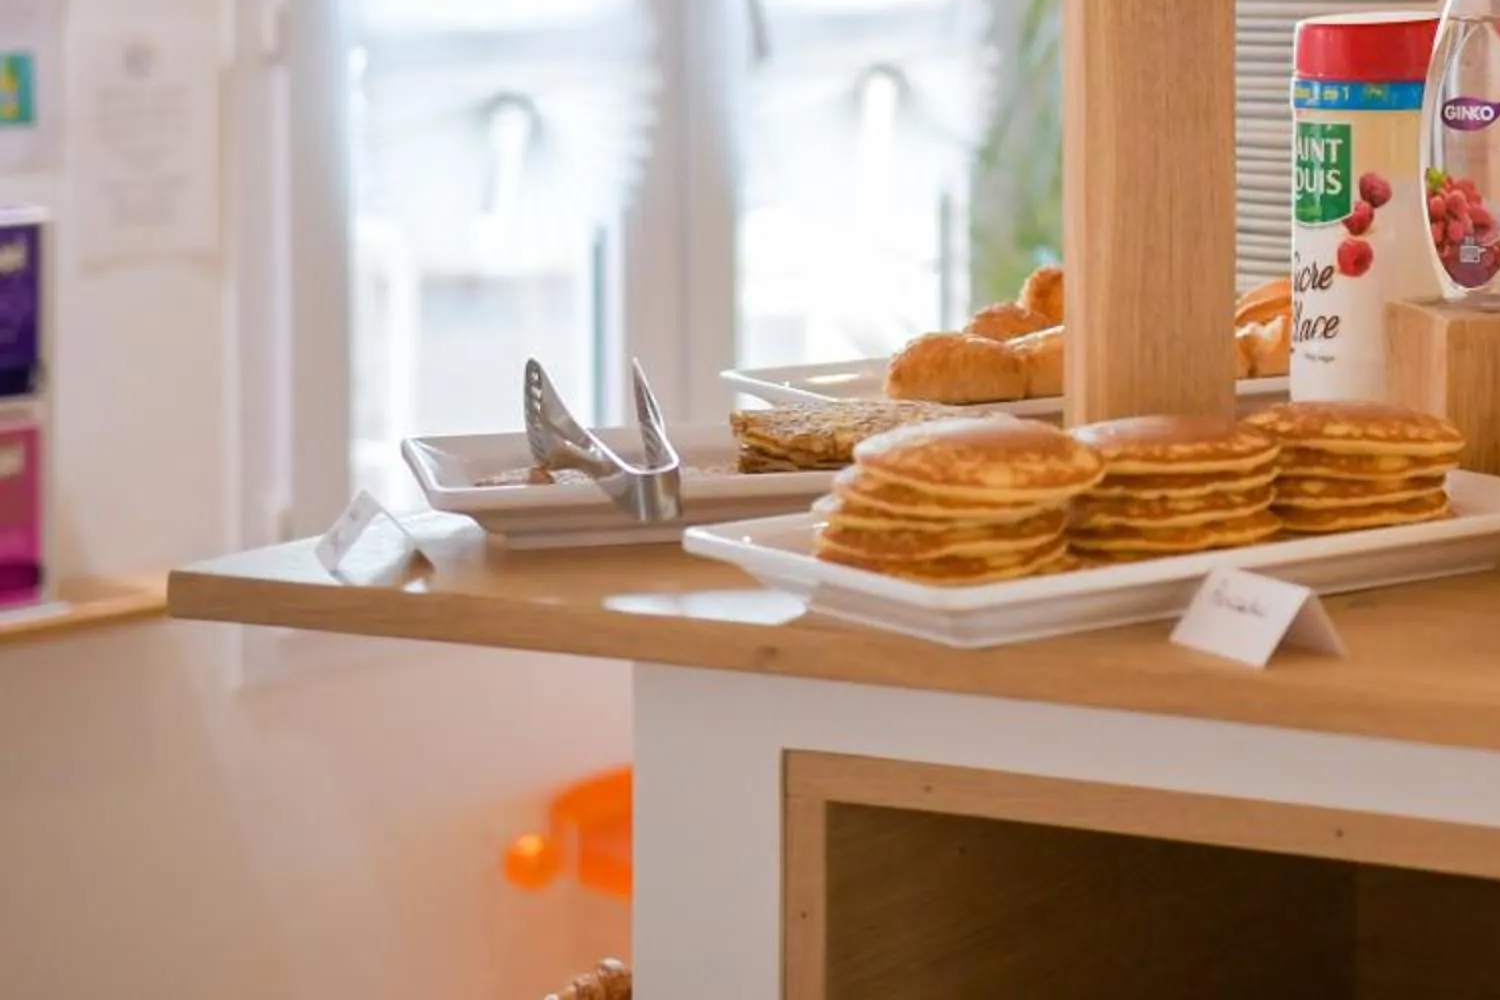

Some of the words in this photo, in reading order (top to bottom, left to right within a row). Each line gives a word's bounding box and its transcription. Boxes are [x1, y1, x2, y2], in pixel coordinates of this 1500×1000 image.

[1444, 105, 1495, 121] GINKO
[1297, 136, 1343, 163] AINT
[1296, 166, 1343, 200] OUIS
